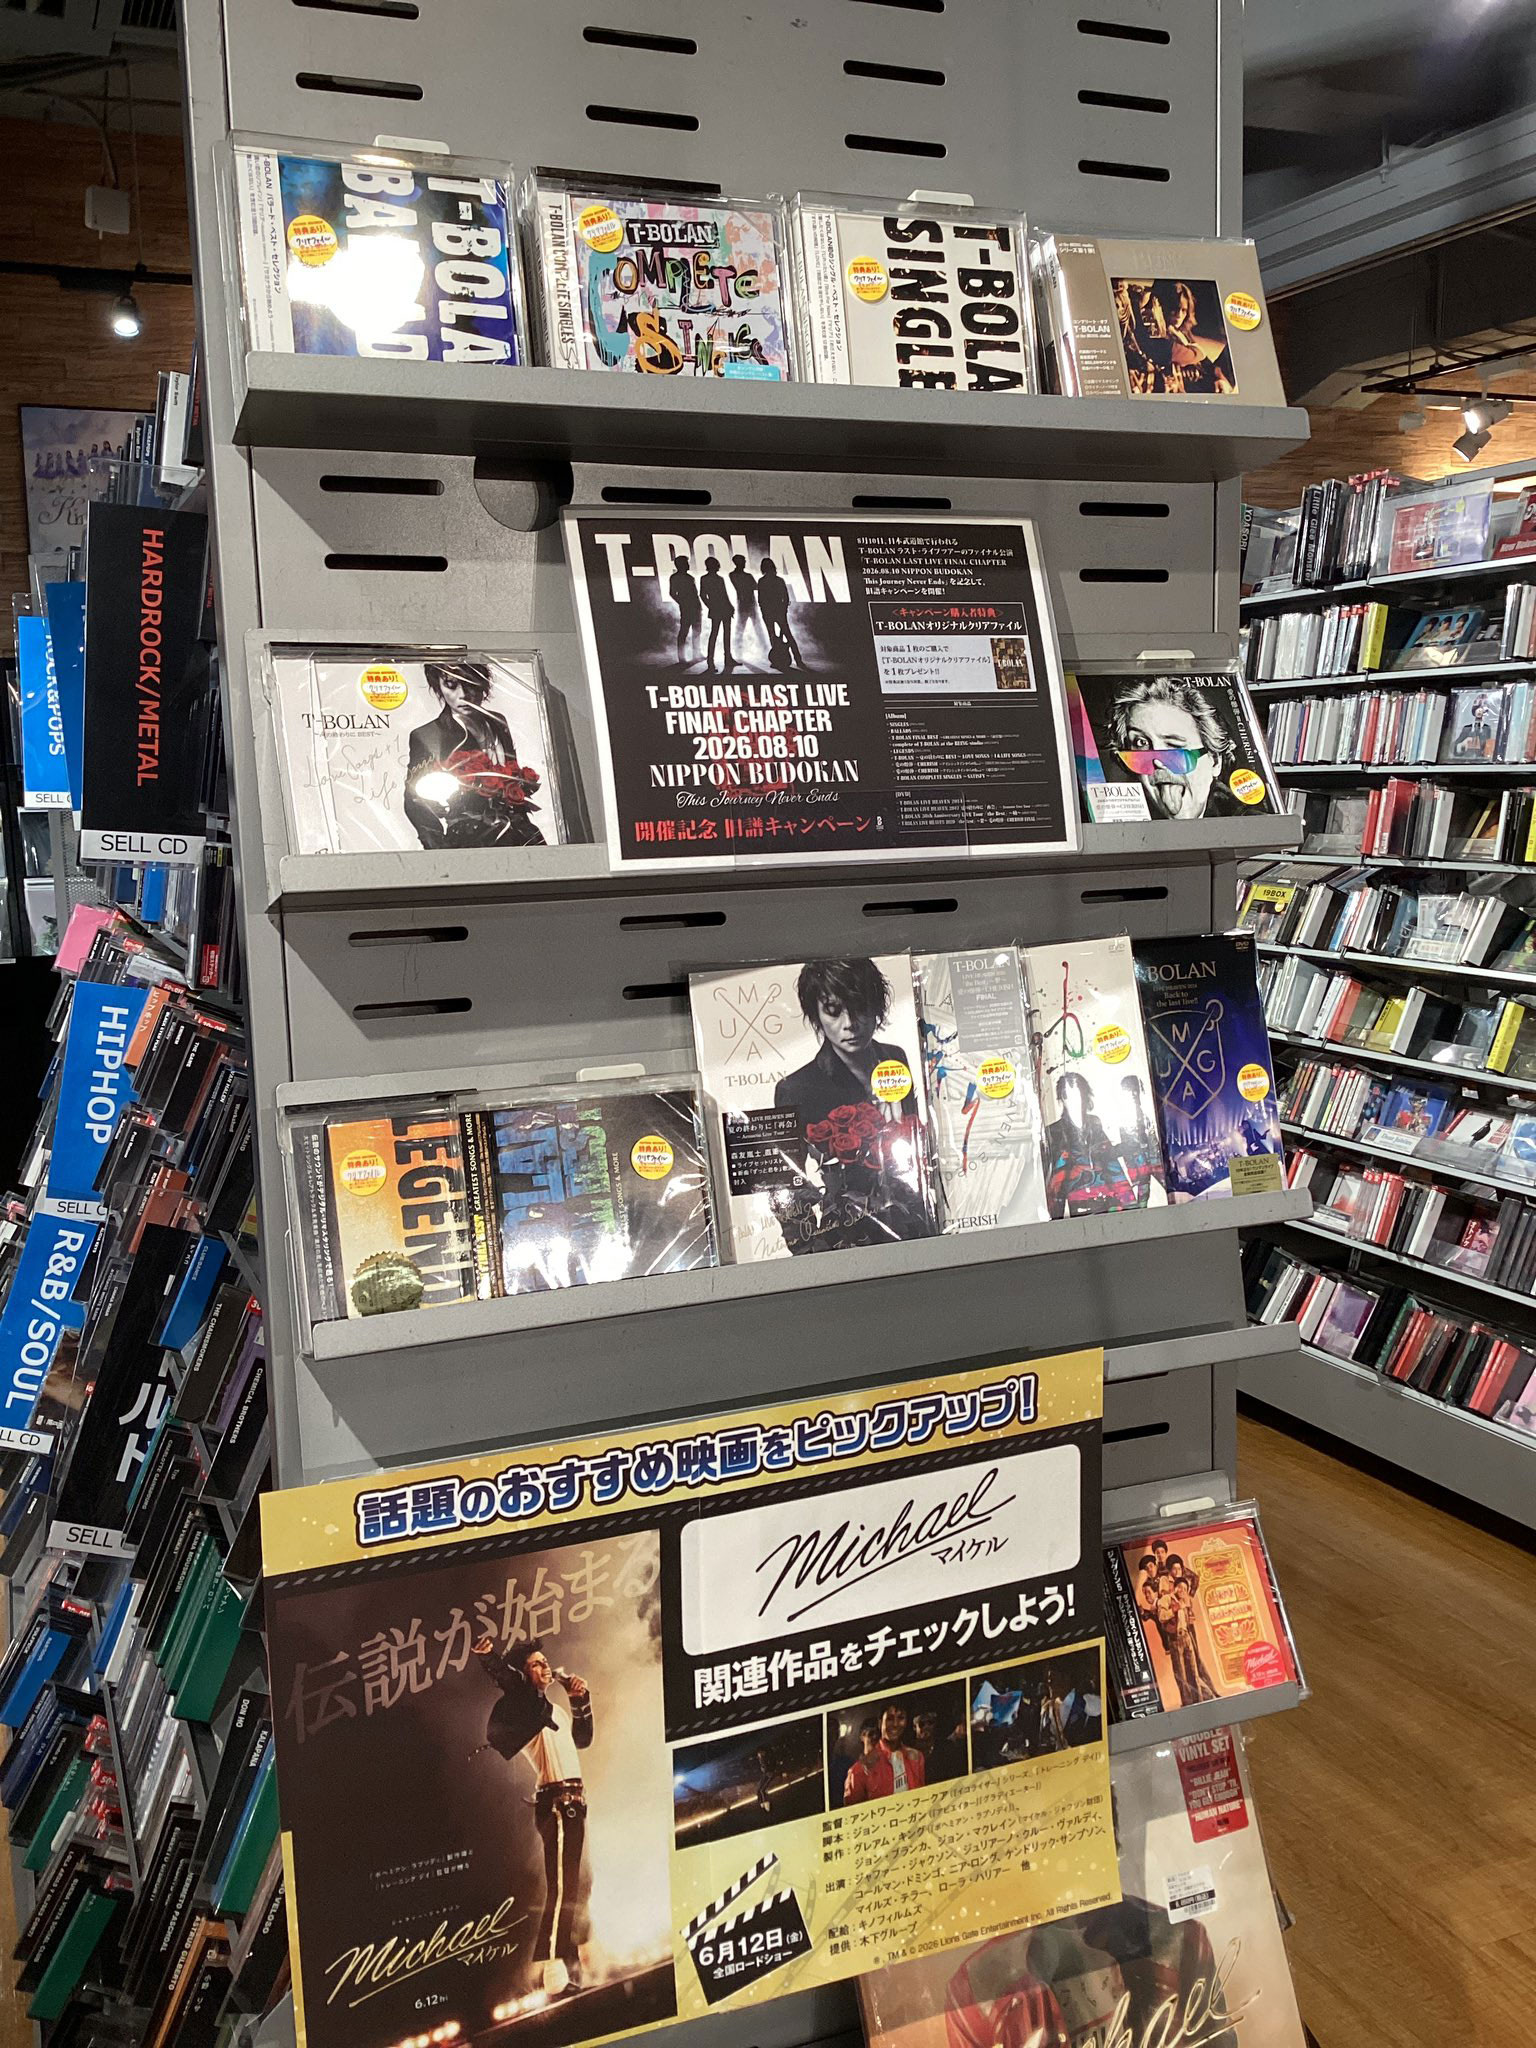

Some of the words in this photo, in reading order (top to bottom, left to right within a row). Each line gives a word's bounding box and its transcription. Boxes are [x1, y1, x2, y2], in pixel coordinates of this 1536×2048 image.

[628, 220, 715, 245] T-BOLAN
[549, 204, 564, 243] T-BOLAN
[559, 301, 574, 345] SINGLES
[1073, 325, 1111, 333] T-BOLAN
[1311, 489, 1321, 515] Little
[1240, 508, 1254, 552] YOASOBI
[1308, 518, 1318, 541] Glee
[594, 534, 851, 603] T-BOLAN
[969, 558, 1007, 566] CHAPTER
[1305, 543, 1316, 581] Monster
[135, 527, 165, 788] HARDROCK/METAL
[1183, 676, 1232, 687] T-BOLAN
[645, 686, 744, 709] T-BOLAN
[747, 684, 800, 707] LAST
[805, 684, 851, 706] LIVE
[302, 713, 391, 730] T-BOLAN
[665, 711, 730, 734] FINAL
[733, 709, 833, 733] CHAPTER
[692, 734, 820, 760] 2026.08.10
[649, 763, 741, 788] NIPPON
[749, 760, 860, 785] BUDOKAN
[35, 793, 64, 804] SELL
[676, 791, 708, 808] This
[710, 789, 763, 808] Journey
[765, 790, 804, 805] Never
[806, 789, 840, 803] Ends
[1091, 786, 1141, 798] T-BOLAN
[634, 817, 718, 843] 開催記念
[724, 815, 871, 839] 旧譜キャンペーン
[100, 834, 152, 855] SELL
[158, 836, 188, 856] CD
[1262, 889, 1287, 898] 19BOX
[84, 1004, 129, 1145] HIPHOP
[724, 1071, 787, 1088] T-BOLAN
[464, 1113, 474, 1135] MORE
[467, 1142, 478, 1168] SONGS
[470, 1167, 483, 1212] GREATEST
[57, 1200, 92, 1217] SELL
[4, 1228, 86, 1410] R&B/SOUL
[212, 1302, 223, 1319] THE
[193, 1318, 218, 1373] CHAINSMOKERS
[245, 1367, 264, 1405] CHEMICAL
[229, 1404, 252, 1445] BROTHERS
[19, 1433, 41, 1447] CD
[357, 1375, 1038, 1546] 話題のおすすめ映画をピックアップ!
[66, 1526, 113, 1548] SELL
[190, 1530, 201, 1549] NANA
[755, 1467, 1017, 1622] Michael
[931, 1536, 1010, 1565] マイケル
[284, 1540, 661, 1744] 伝説が始まる
[694, 1583, 1075, 1709] 関連作品をチェックしよう!
[240, 1698, 250, 1715] DON
[235, 1714, 244, 1728] HO
[249, 1729, 270, 1768] KALAPANA
[1179, 1742, 1211, 1763] VINYL
[1212, 1736, 1231, 1754] SET
[1021, 1860, 1031, 1871] 他
[262, 1900, 281, 1935] VELOSO
[917, 1942, 939, 1953] 2026
[939, 1935, 960, 1948] Lions
[962, 1929, 979, 1942] Gate
[980, 1916, 1029, 1936] Entertainment
[1045, 1907, 1055, 1918] All
[1056, 1901, 1078, 1914] Rights
[186, 1916, 202, 1950] ASTRUD
[325, 1897, 529, 2008] Michael
[457, 1942, 519, 1968] マイケル
[699, 1927, 804, 1967] 6月12日(金)
[168, 1949, 189, 1991] GILBERTO
[712, 1950, 793, 1980] 全国ロードショー
